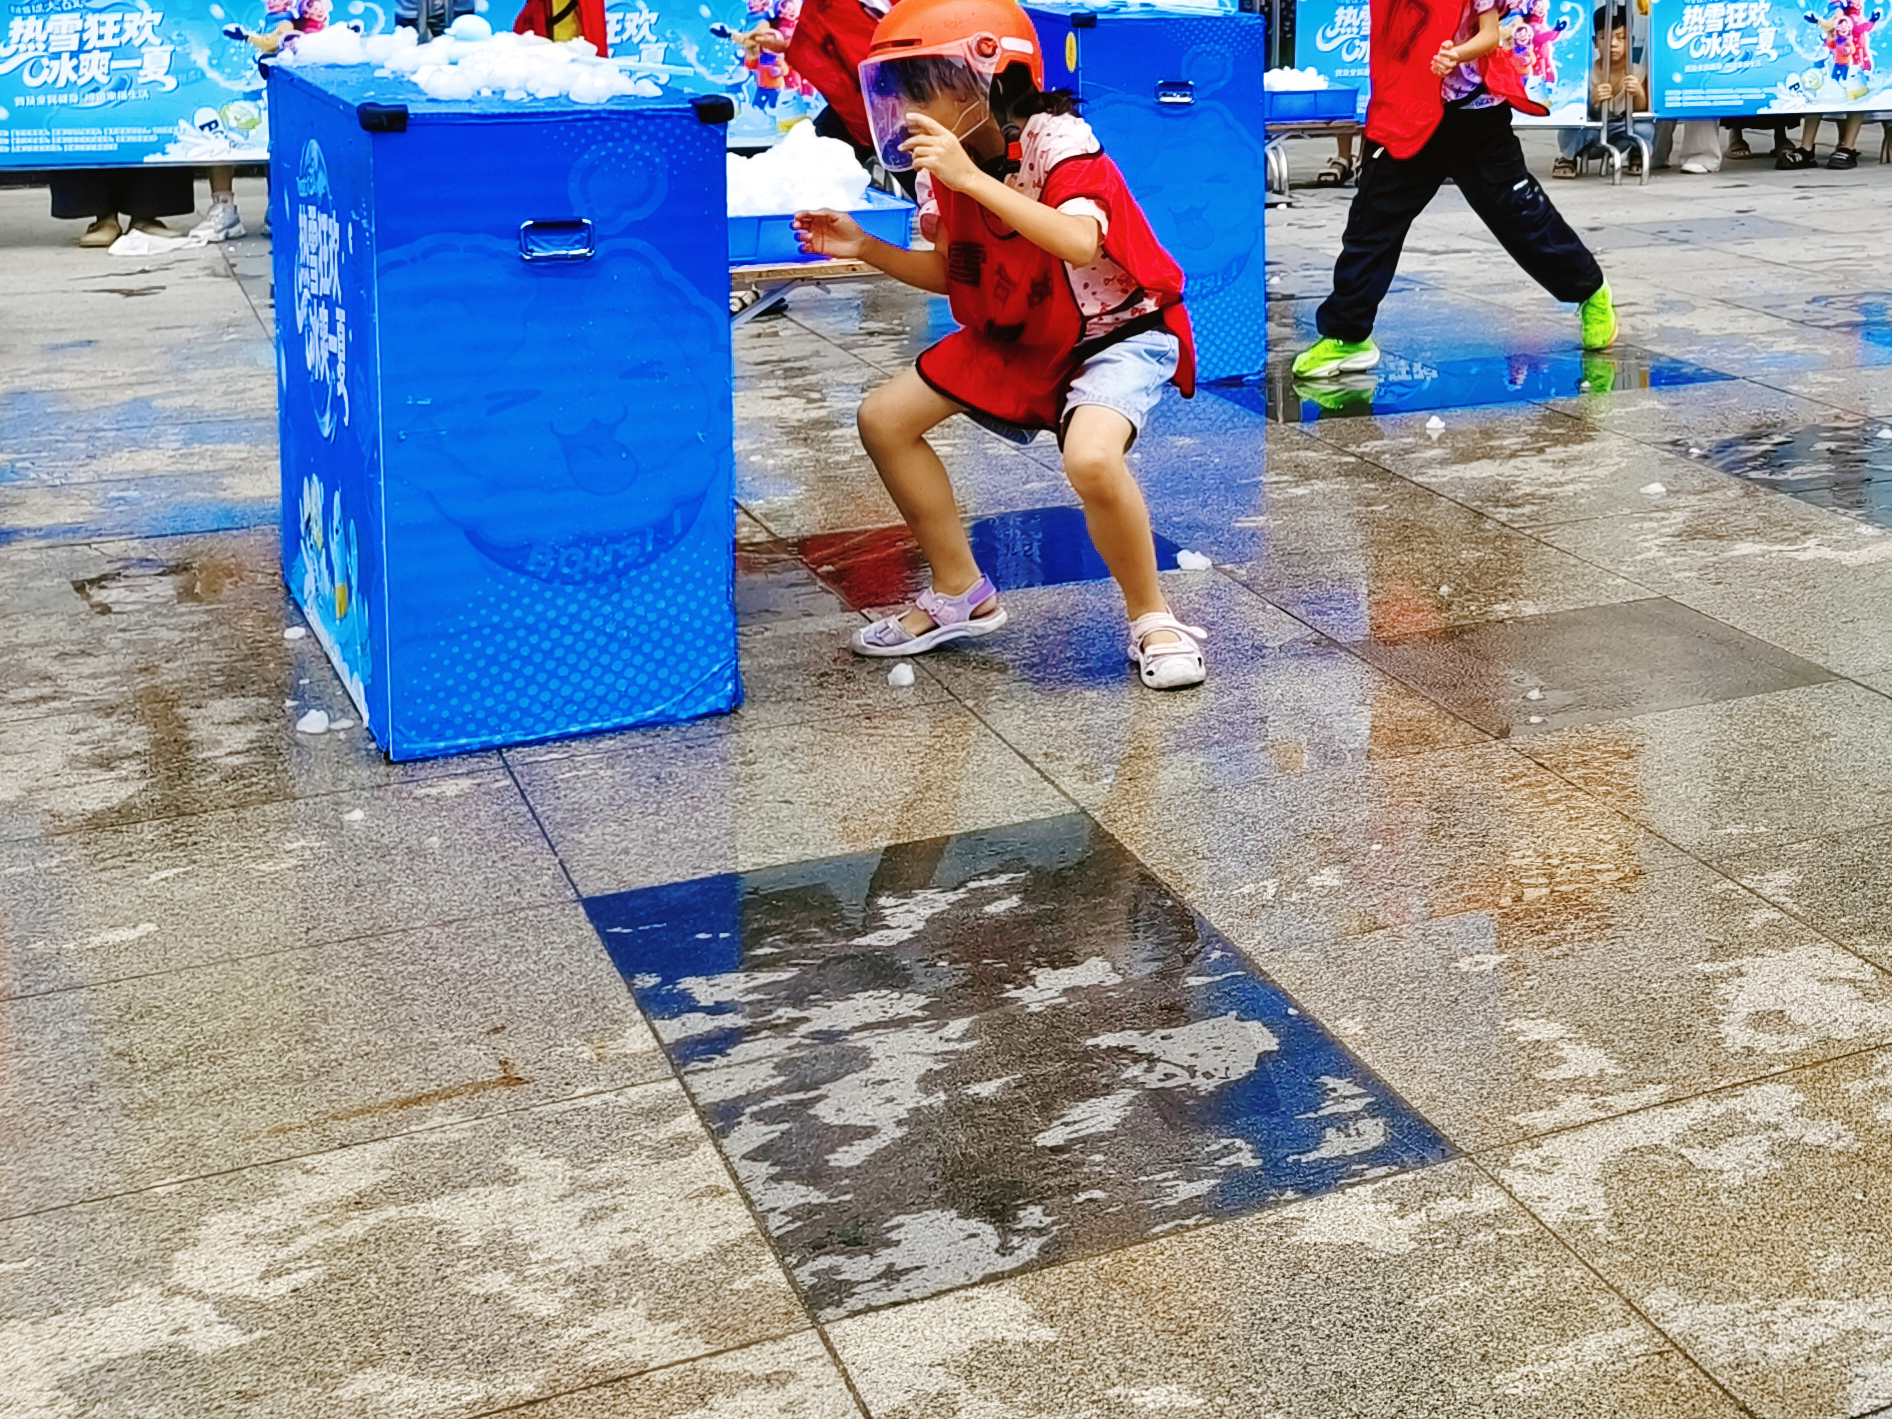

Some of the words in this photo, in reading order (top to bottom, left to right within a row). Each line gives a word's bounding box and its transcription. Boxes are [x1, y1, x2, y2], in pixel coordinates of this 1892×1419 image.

[8, 8, 165, 55] 热雪狂欢
[1680, 0, 1772, 32] 热雪狂欢
[1690, 26, 1779, 63] 冰爽一夏
[23, 44, 179, 92] 冰爽一夏
